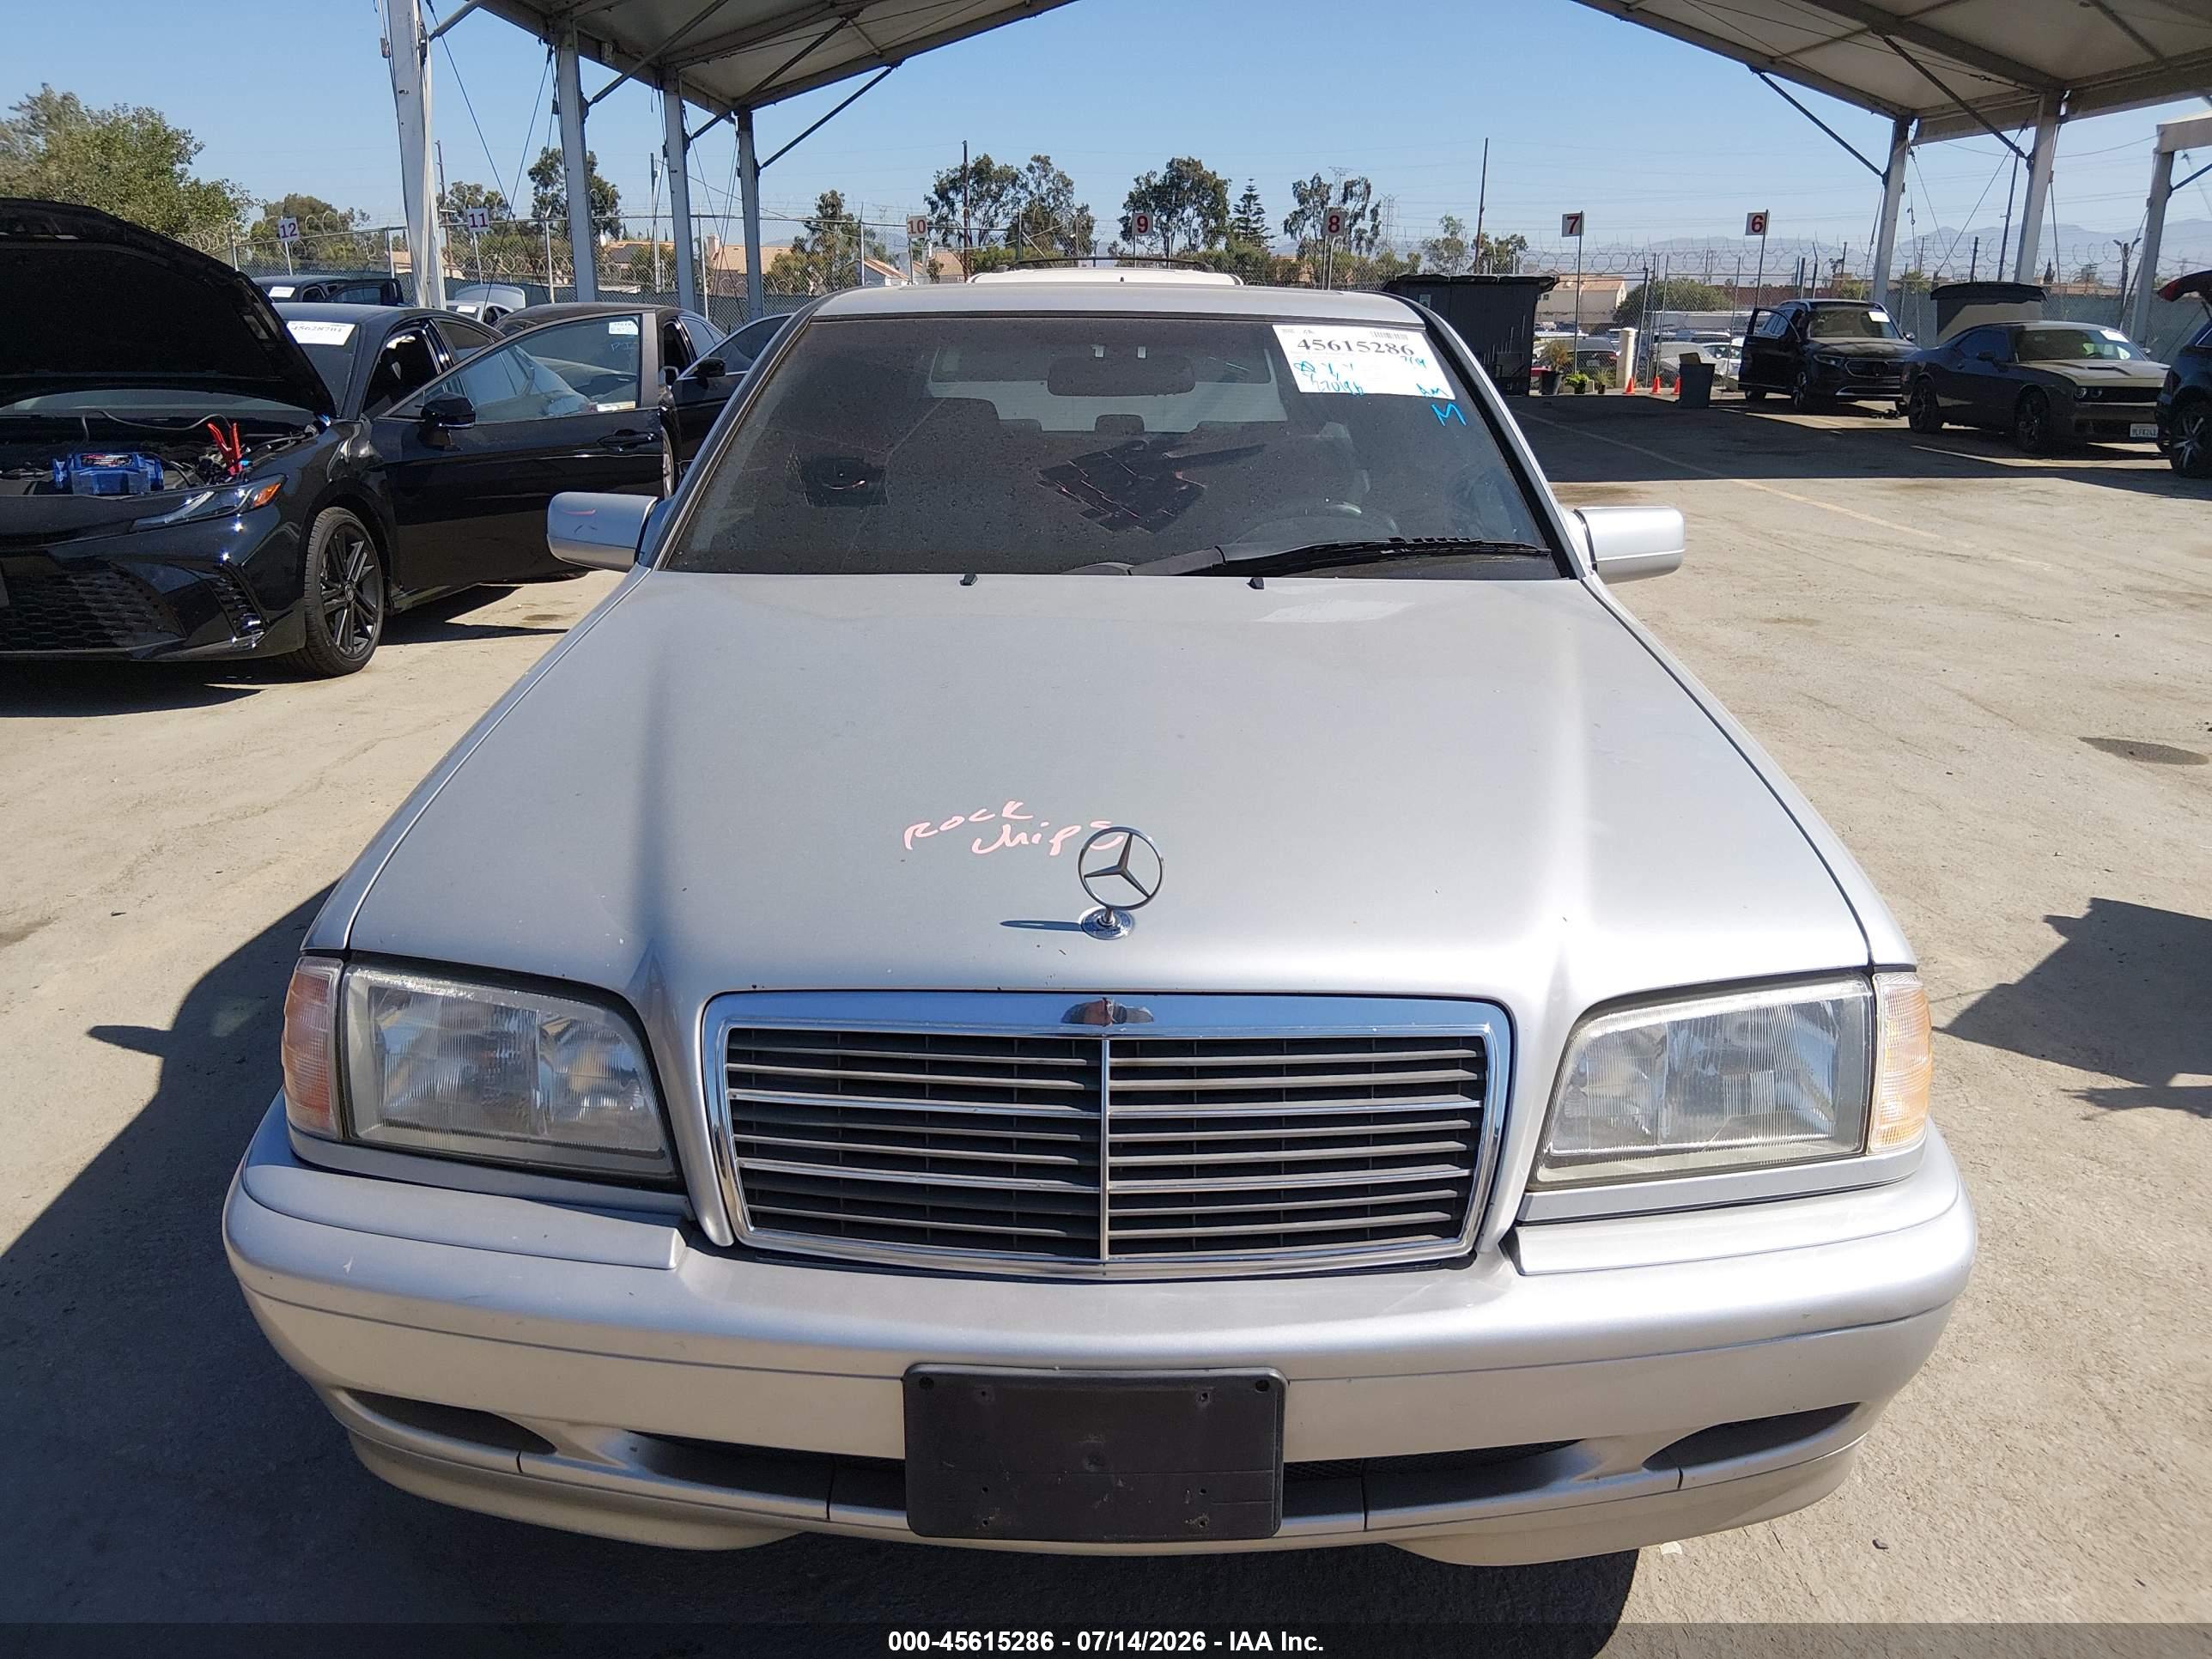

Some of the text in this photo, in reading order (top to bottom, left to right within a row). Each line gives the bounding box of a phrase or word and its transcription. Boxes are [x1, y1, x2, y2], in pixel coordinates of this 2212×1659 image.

[469, 212, 489, 228] 11
[907, 219, 927, 234] 10
[1137, 216, 1149, 234] 9
[1328, 215, 1340, 234] 8
[1566, 216, 1580, 234] 7
[1752, 215, 1764, 234] 6
[280, 222, 298, 239] 12
[1297, 337, 1415, 356] 45615286
[1430, 402, 1468, 427] M
